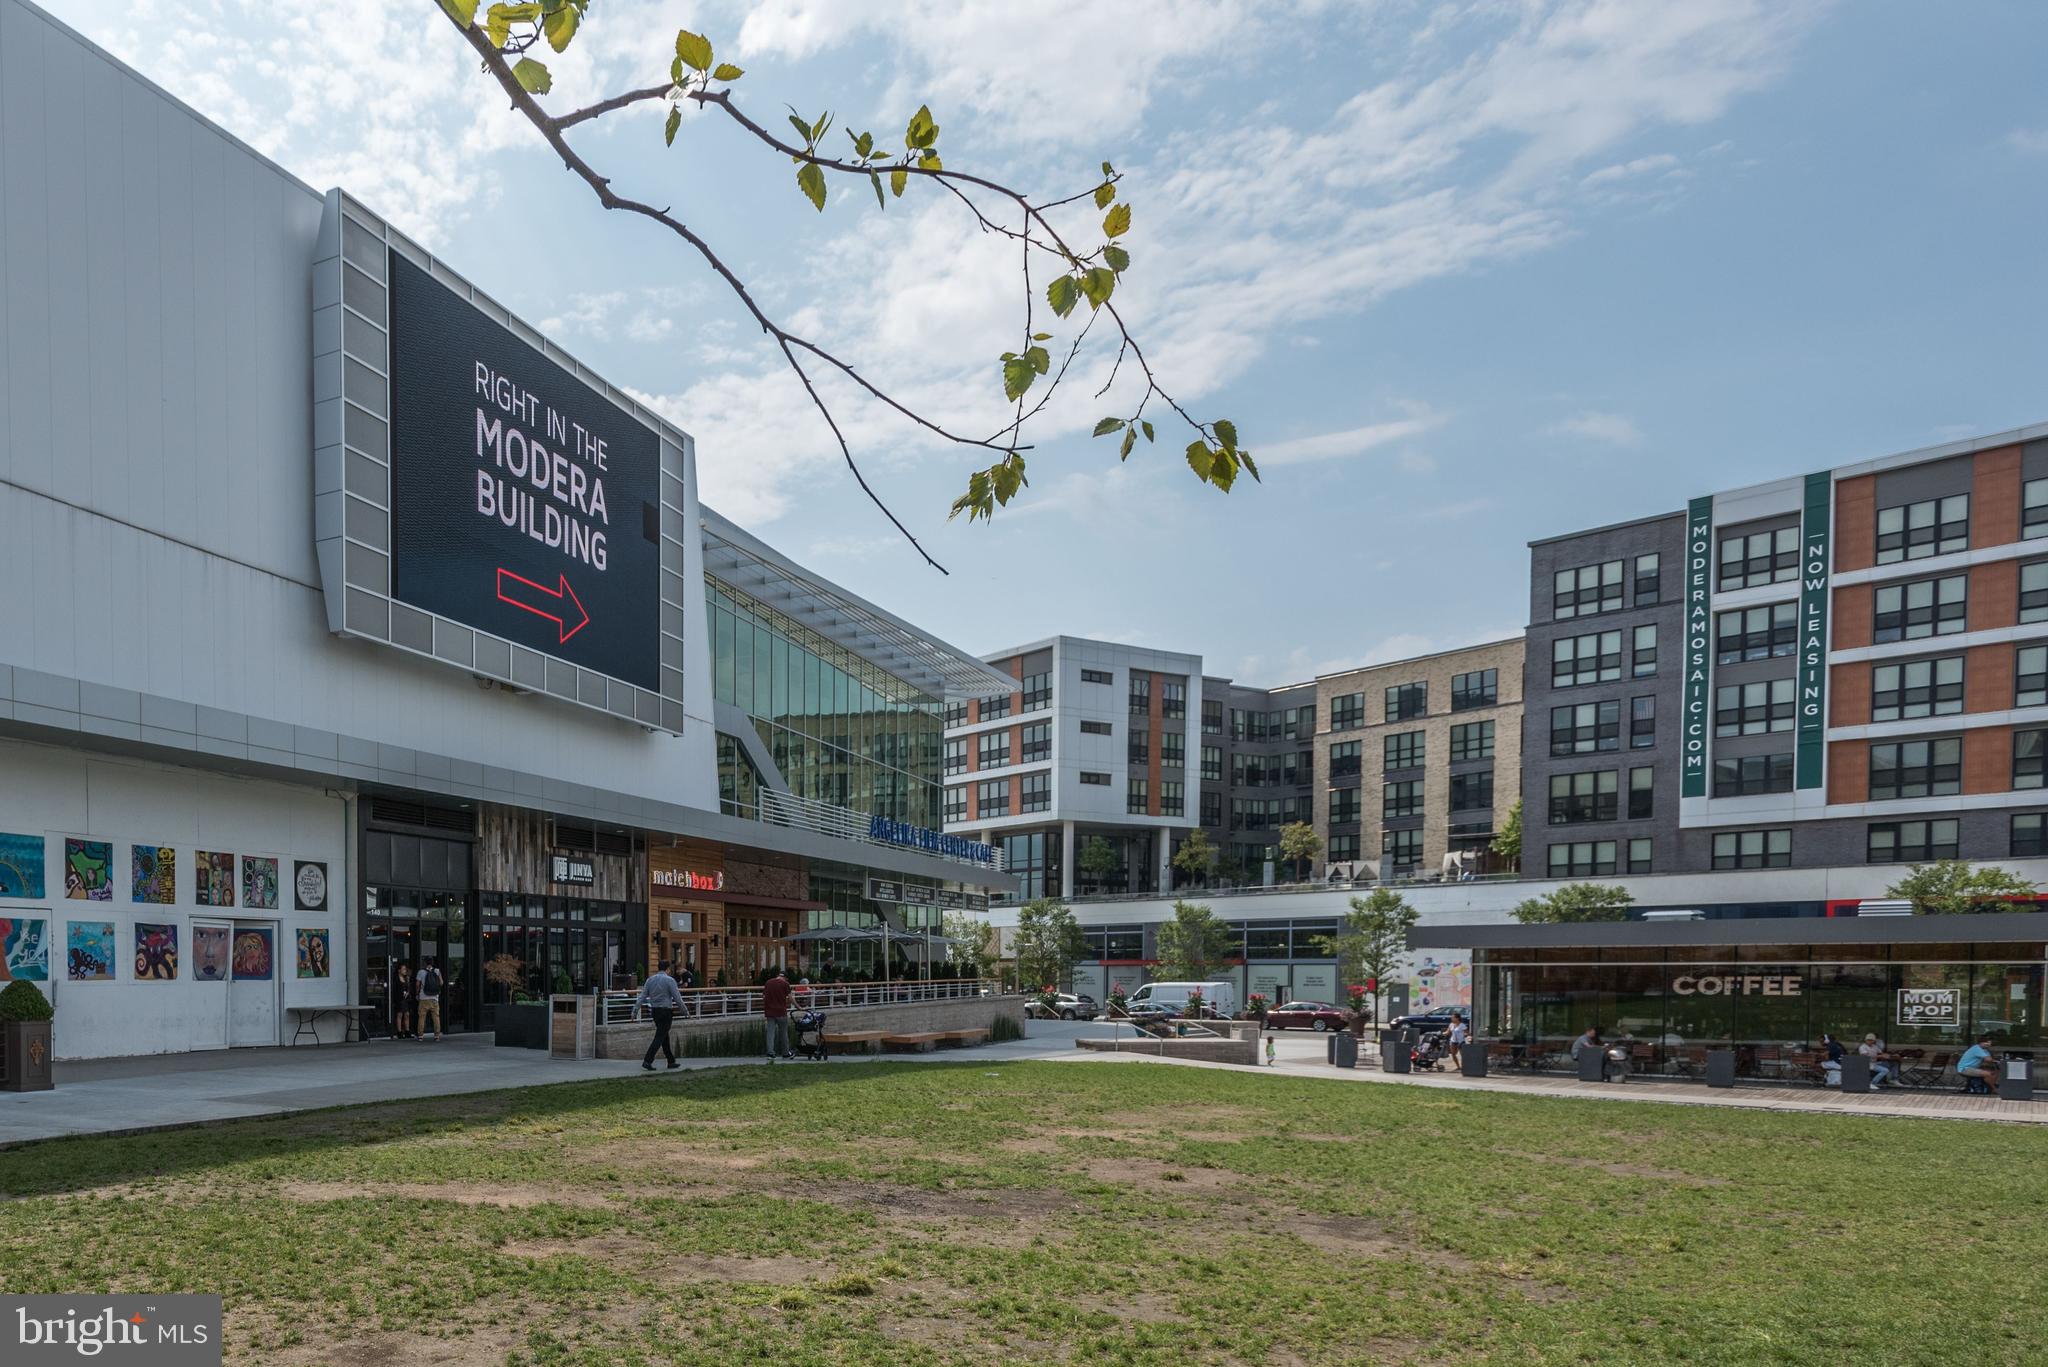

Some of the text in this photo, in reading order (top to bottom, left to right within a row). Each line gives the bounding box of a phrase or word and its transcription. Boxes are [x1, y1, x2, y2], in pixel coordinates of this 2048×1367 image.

[475, 360, 608, 472] RIGHT IN THE
[476, 407, 609, 526] MODERA
[477, 469, 608, 571] BUILDING
[1686, 524, 1708, 768] MODERAMOSAIC.COM
[1804, 544, 1825, 716] NOW LEASING
[569, 862, 593, 880] JINYA
[653, 869, 714, 891] matchbox
[1672, 976, 1802, 996] COFFEE
[1904, 993, 1953, 1004] MOM
